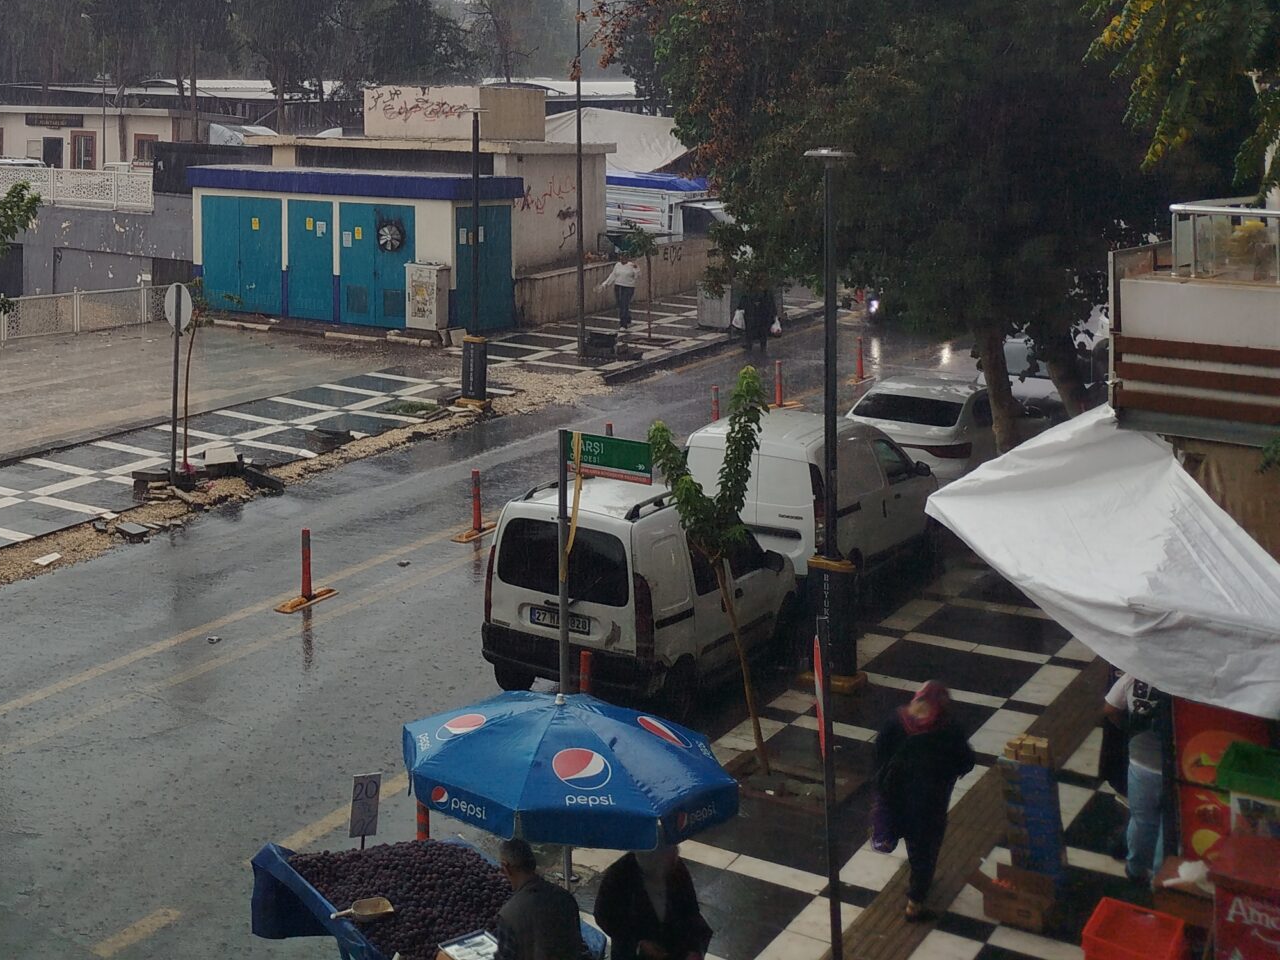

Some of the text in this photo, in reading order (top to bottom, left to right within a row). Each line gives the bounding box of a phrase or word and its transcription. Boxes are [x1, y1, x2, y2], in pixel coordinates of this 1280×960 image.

[536, 610, 547, 622] 27
[353, 780, 379, 802] 20
[565, 794, 614, 807] pepsi
[451, 797, 487, 820] pepsi
[689, 801, 717, 825] pepsi
